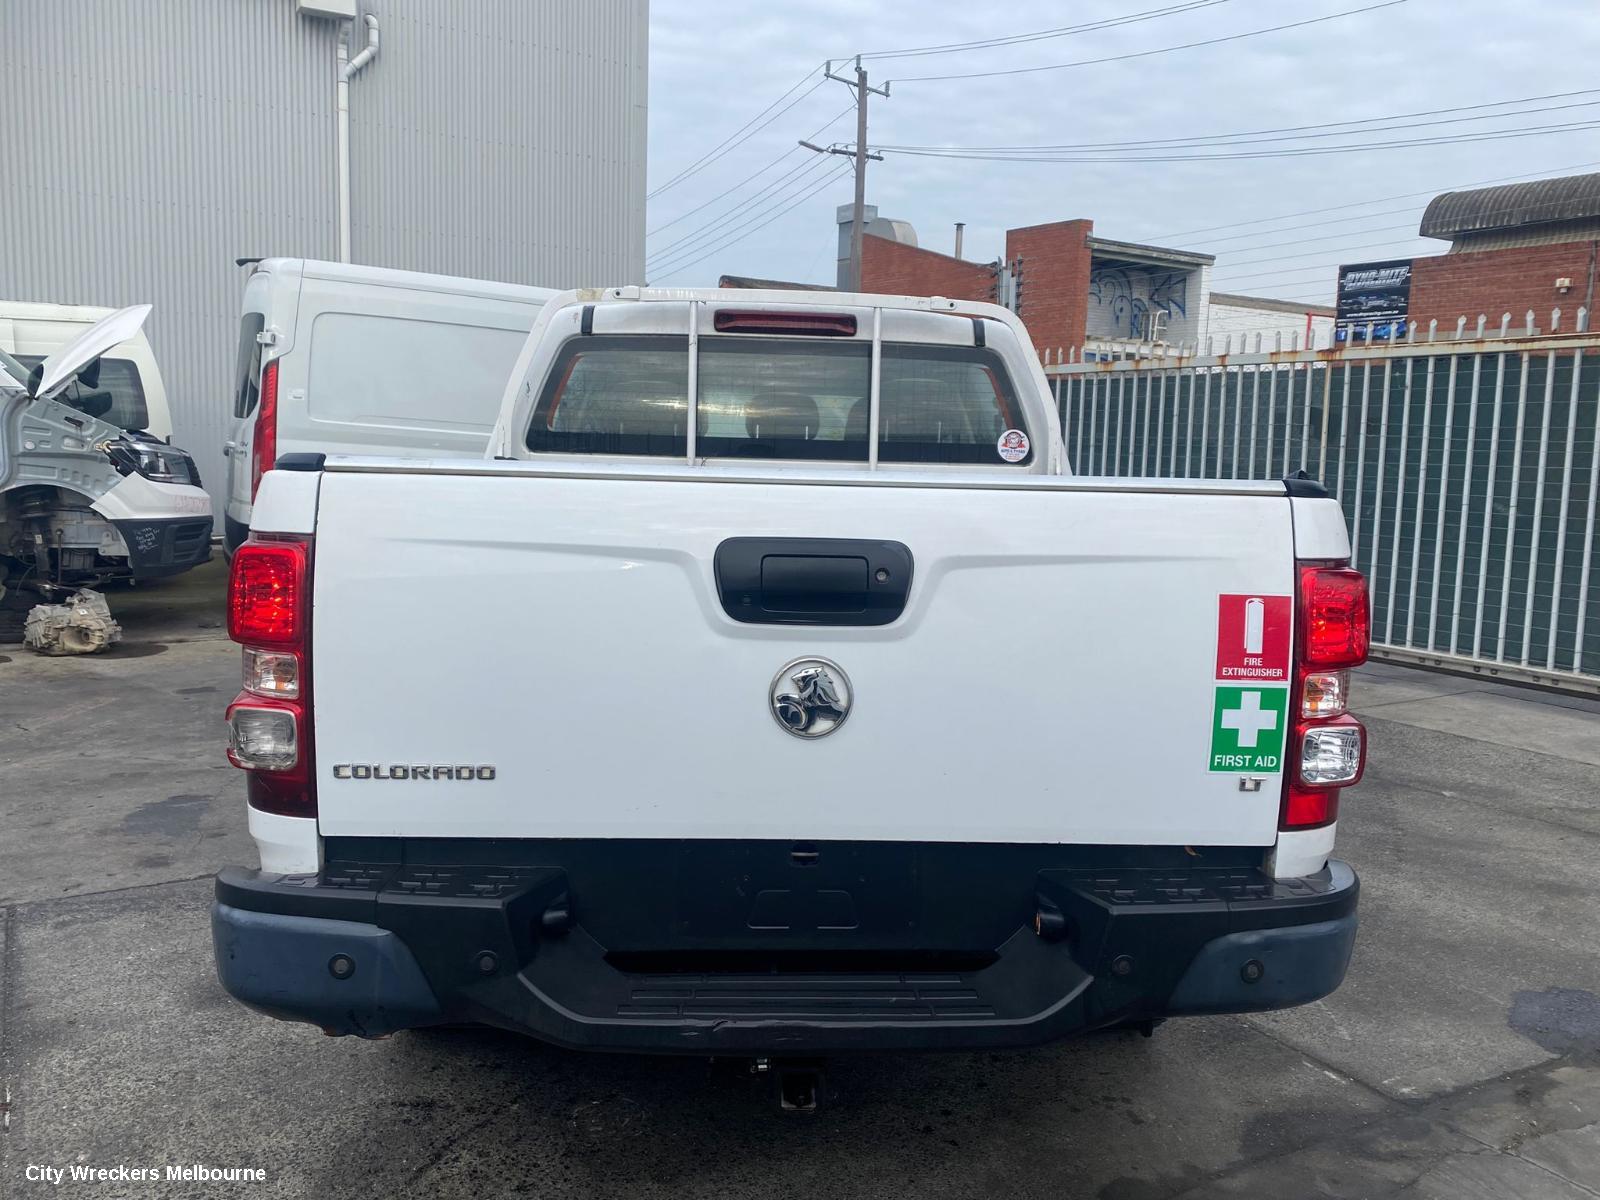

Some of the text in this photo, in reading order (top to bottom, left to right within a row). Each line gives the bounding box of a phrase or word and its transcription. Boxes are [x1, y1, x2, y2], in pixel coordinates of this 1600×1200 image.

[1346, 268, 1407, 282] DYNO-MITE
[1244, 657, 1263, 666] FIRE
[1222, 667, 1283, 677] EXTINGUISHER
[1214, 754, 1277, 767] FIRST AID
[333, 763, 497, 780] COLORADO
